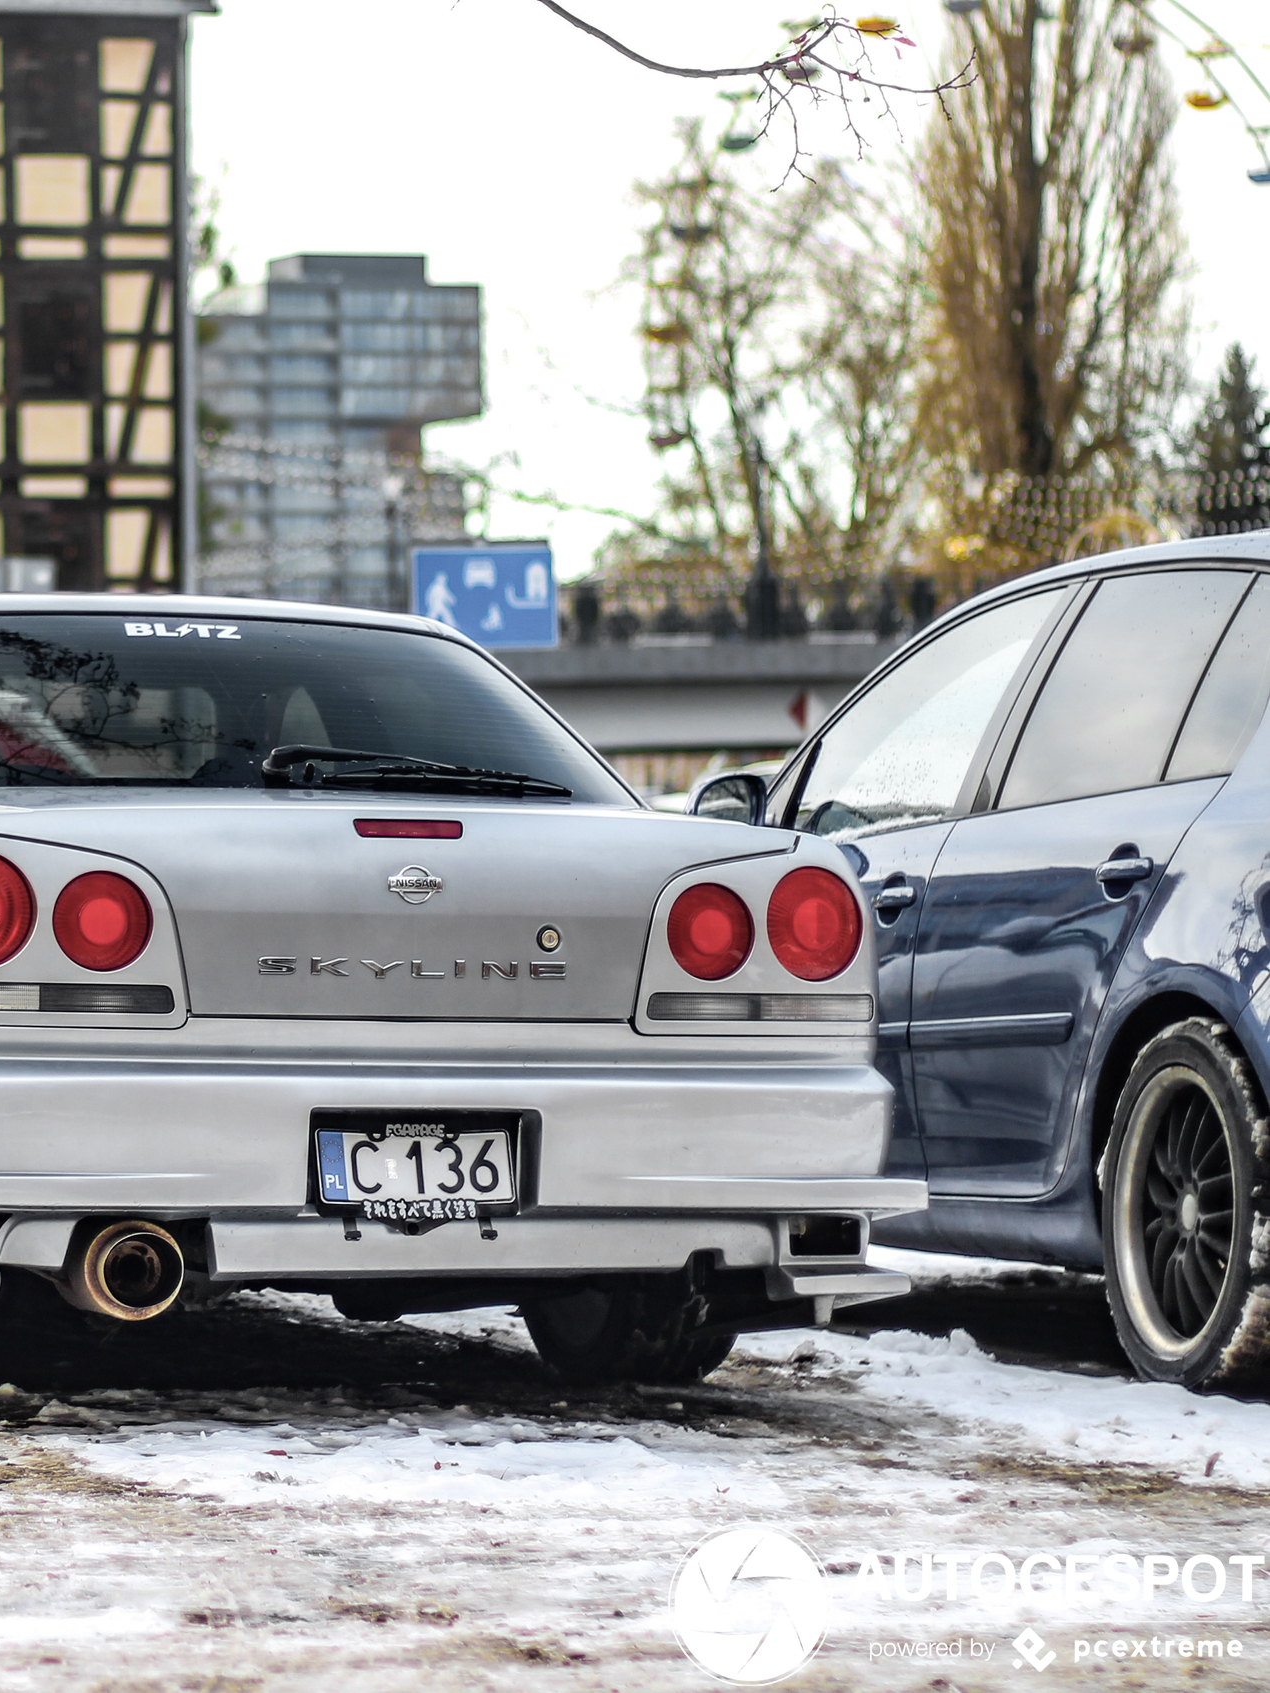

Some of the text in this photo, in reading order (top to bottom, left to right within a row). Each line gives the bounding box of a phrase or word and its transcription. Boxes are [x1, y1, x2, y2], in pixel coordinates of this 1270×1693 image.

[124, 622, 242, 640] BLITZ
[395, 878, 438, 889] NISSAN
[257, 955, 567, 980] SKYLINE
[385, 1123, 445, 1138] FGARAGE
[351, 1139, 499, 1194] C 136
[325, 1174, 344, 1190] PL
